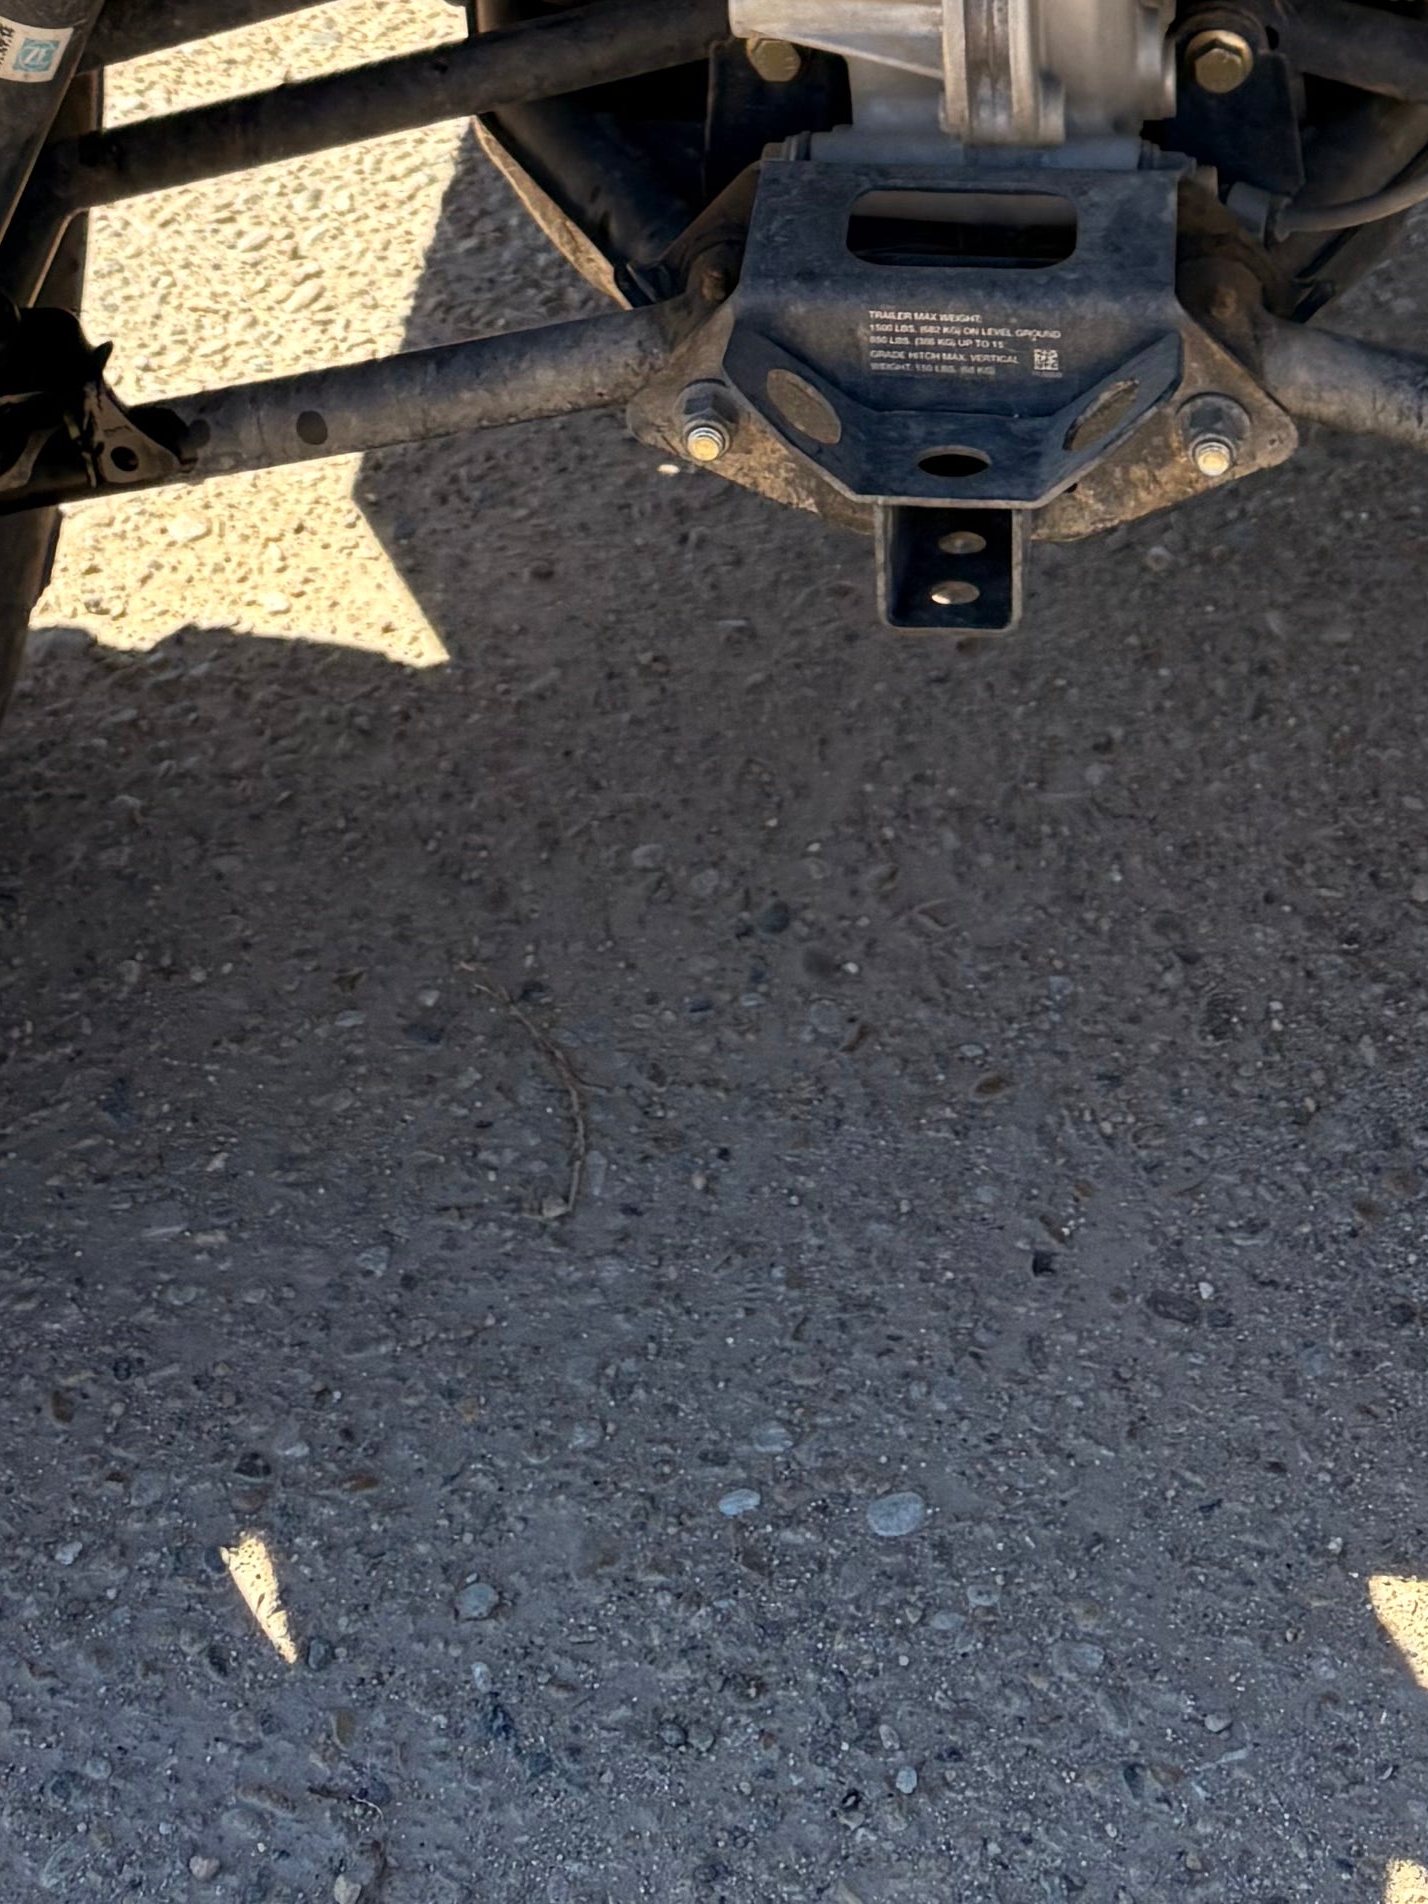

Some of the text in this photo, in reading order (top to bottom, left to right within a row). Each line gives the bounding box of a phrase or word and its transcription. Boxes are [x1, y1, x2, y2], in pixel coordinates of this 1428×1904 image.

[869, 310, 912, 320] TRAILER
[913, 312, 937, 321] MAX
[963, 327, 979, 335] ON
[981, 327, 1012, 337] LEVEL
[1014, 328, 1062, 339] GROUND
[958, 339, 973, 347] UP
[975, 339, 990, 348] TO
[870, 350, 905, 359] GRADE
[908, 351, 941, 360] HITCH
[970, 354, 1020, 364] VERTICAL
